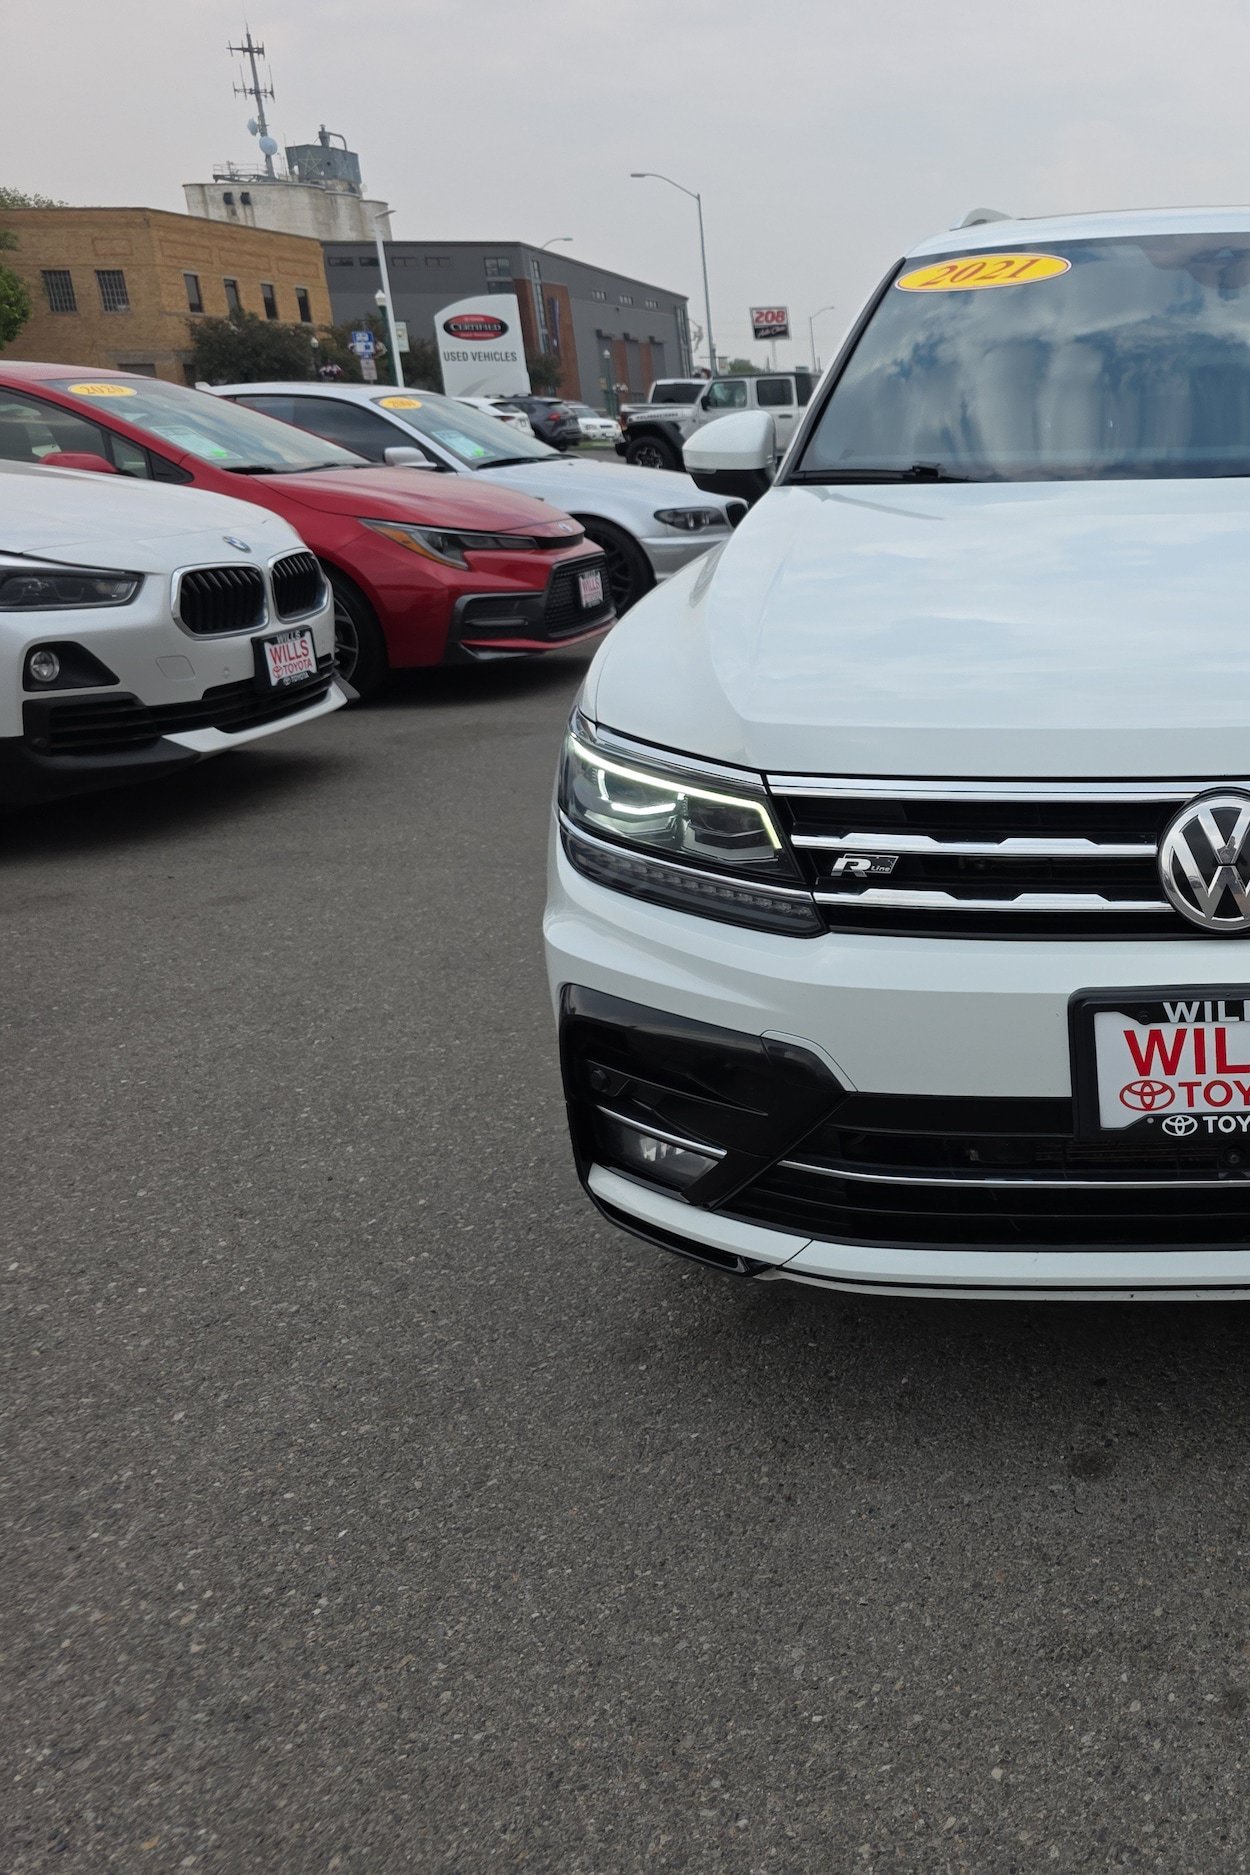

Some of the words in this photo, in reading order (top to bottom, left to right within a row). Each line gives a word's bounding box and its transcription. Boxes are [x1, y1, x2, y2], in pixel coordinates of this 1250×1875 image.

[917, 258, 1041, 287] 2021
[755, 310, 785, 323] 208
[443, 351, 468, 362] USED
[471, 351, 517, 362] VEHICLES
[277, 630, 301, 644] WILLS
[270, 639, 310, 665] WILLS
[283, 658, 313, 674] TOYOTA
